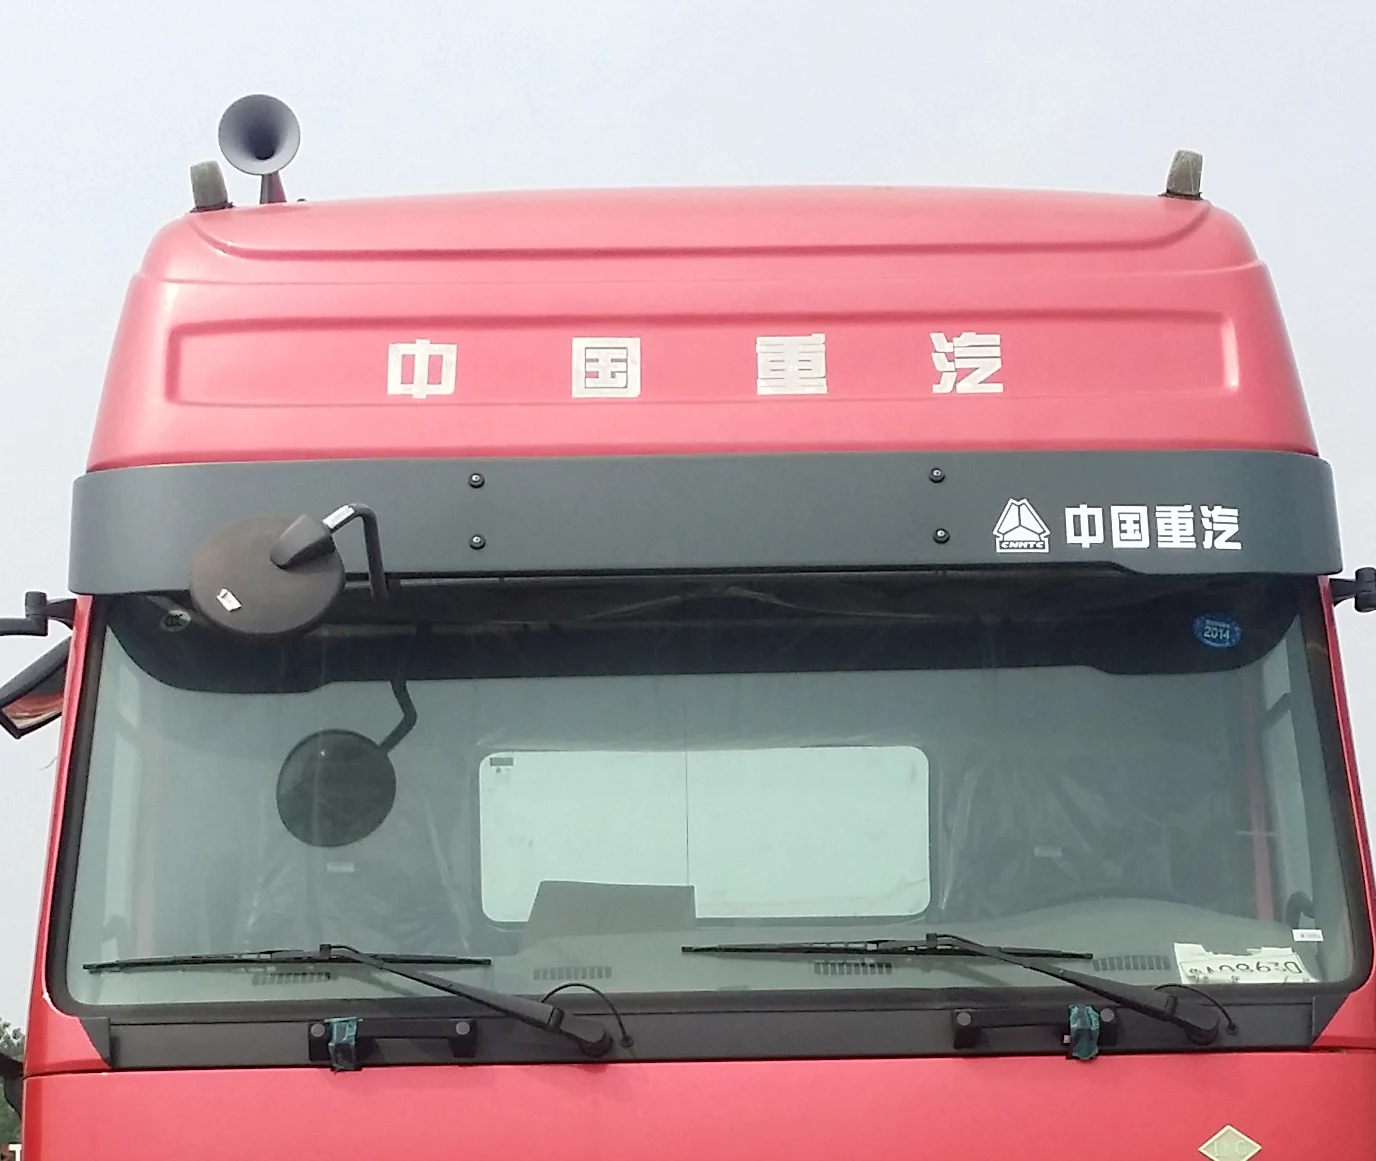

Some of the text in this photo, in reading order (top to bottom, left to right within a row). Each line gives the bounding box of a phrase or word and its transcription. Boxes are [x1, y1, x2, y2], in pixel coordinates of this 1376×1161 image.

[387, 332, 1004, 399] 中国重汽
[1065, 504, 1242, 550] 中国重汽
[1204, 626, 1230, 640] 2014
